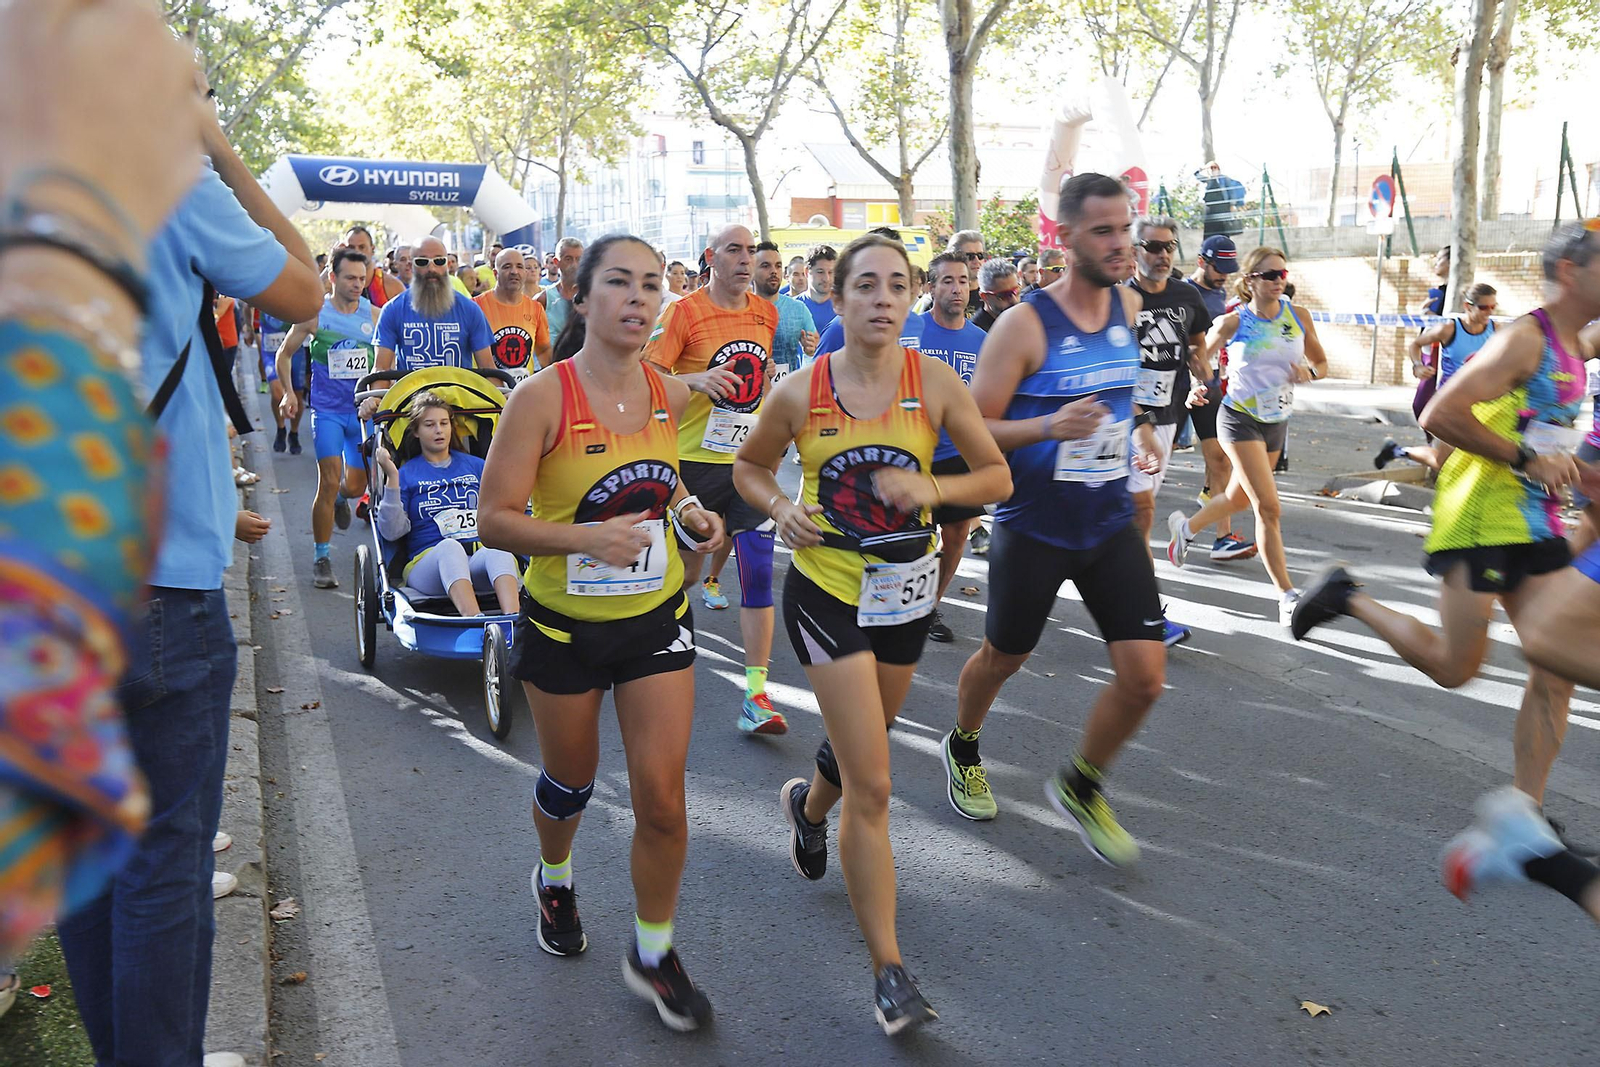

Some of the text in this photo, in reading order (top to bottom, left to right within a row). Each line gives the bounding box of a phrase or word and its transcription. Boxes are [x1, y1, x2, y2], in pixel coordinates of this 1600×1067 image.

[364, 169, 460, 187] HYUNDAI
[409, 190, 460, 202] SYRLUZ
[494, 327, 531, 341] SPARTAN
[715, 342, 767, 364] SPARTAN
[346, 356, 367, 370] 422
[730, 424, 755, 443] 73
[821, 447, 918, 480] SPARTAN
[587, 463, 678, 504] SPARTAN
